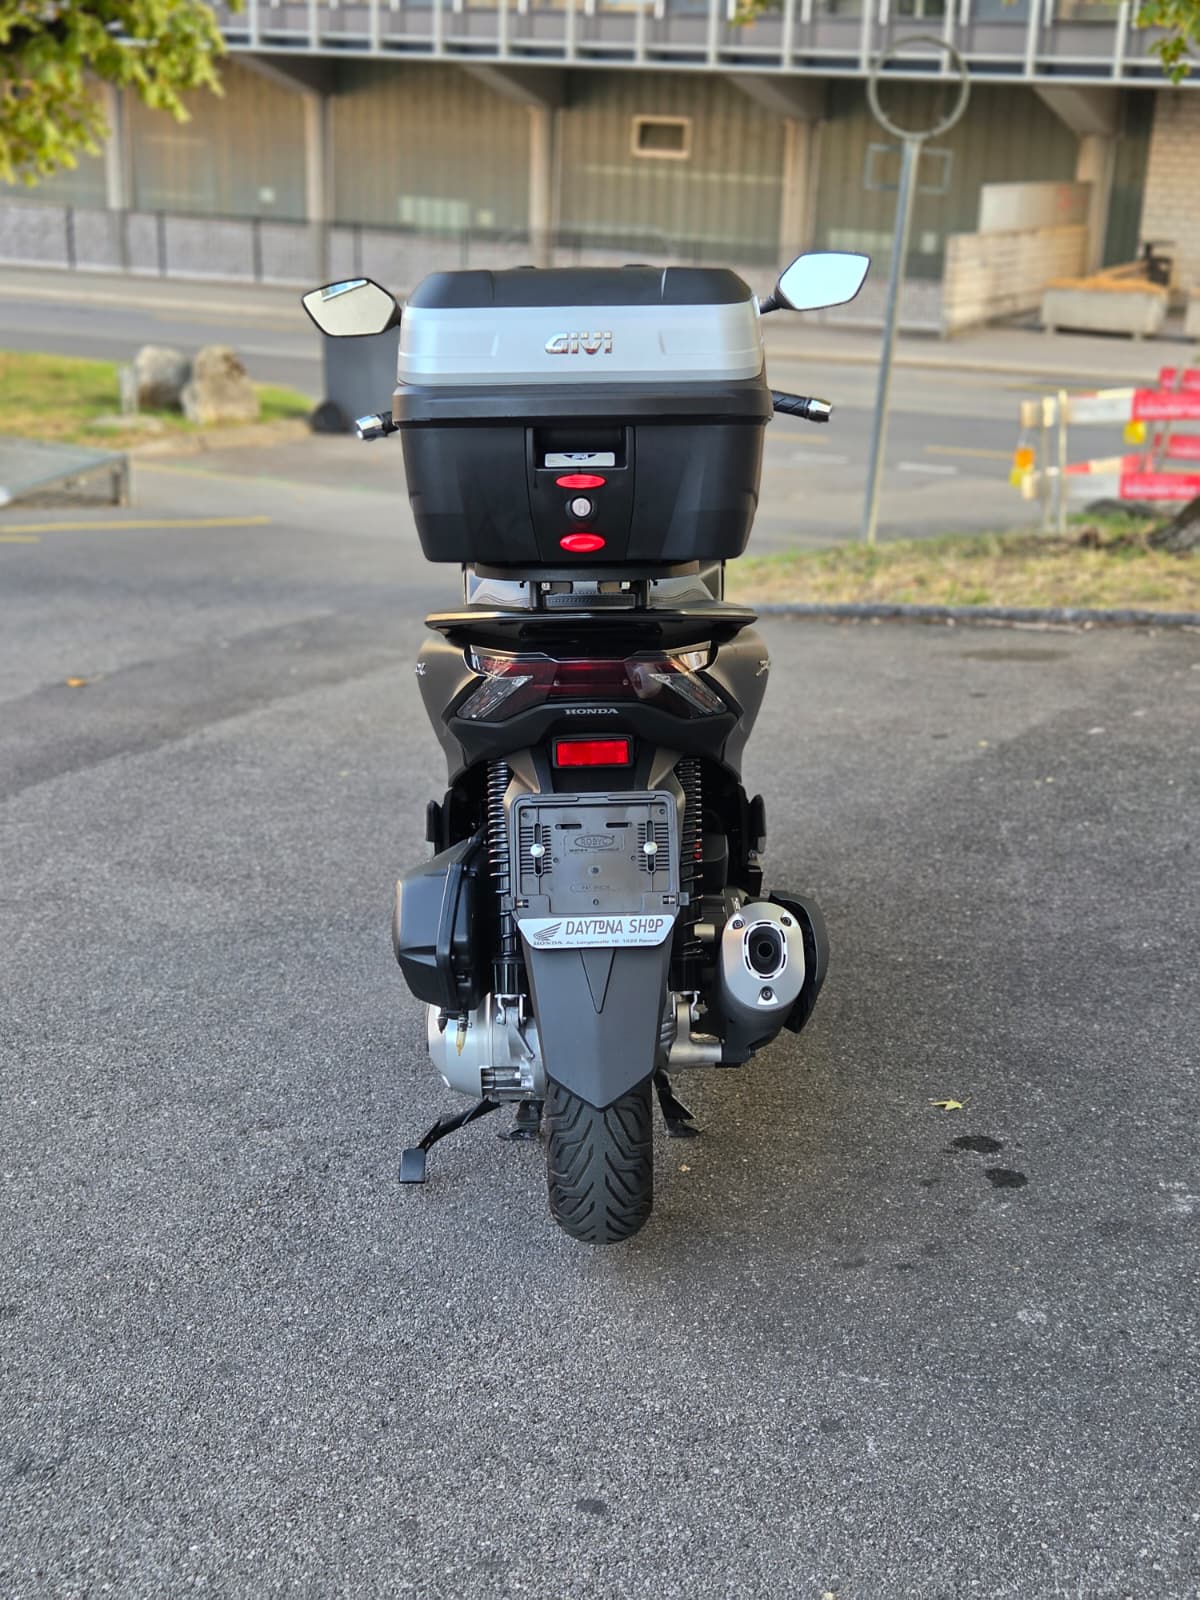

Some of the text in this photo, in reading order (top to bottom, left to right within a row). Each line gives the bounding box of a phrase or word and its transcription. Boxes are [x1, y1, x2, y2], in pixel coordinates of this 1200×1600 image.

[544, 331, 612, 355] GIVI
[565, 918, 664, 935] DAYTONA SHOP
